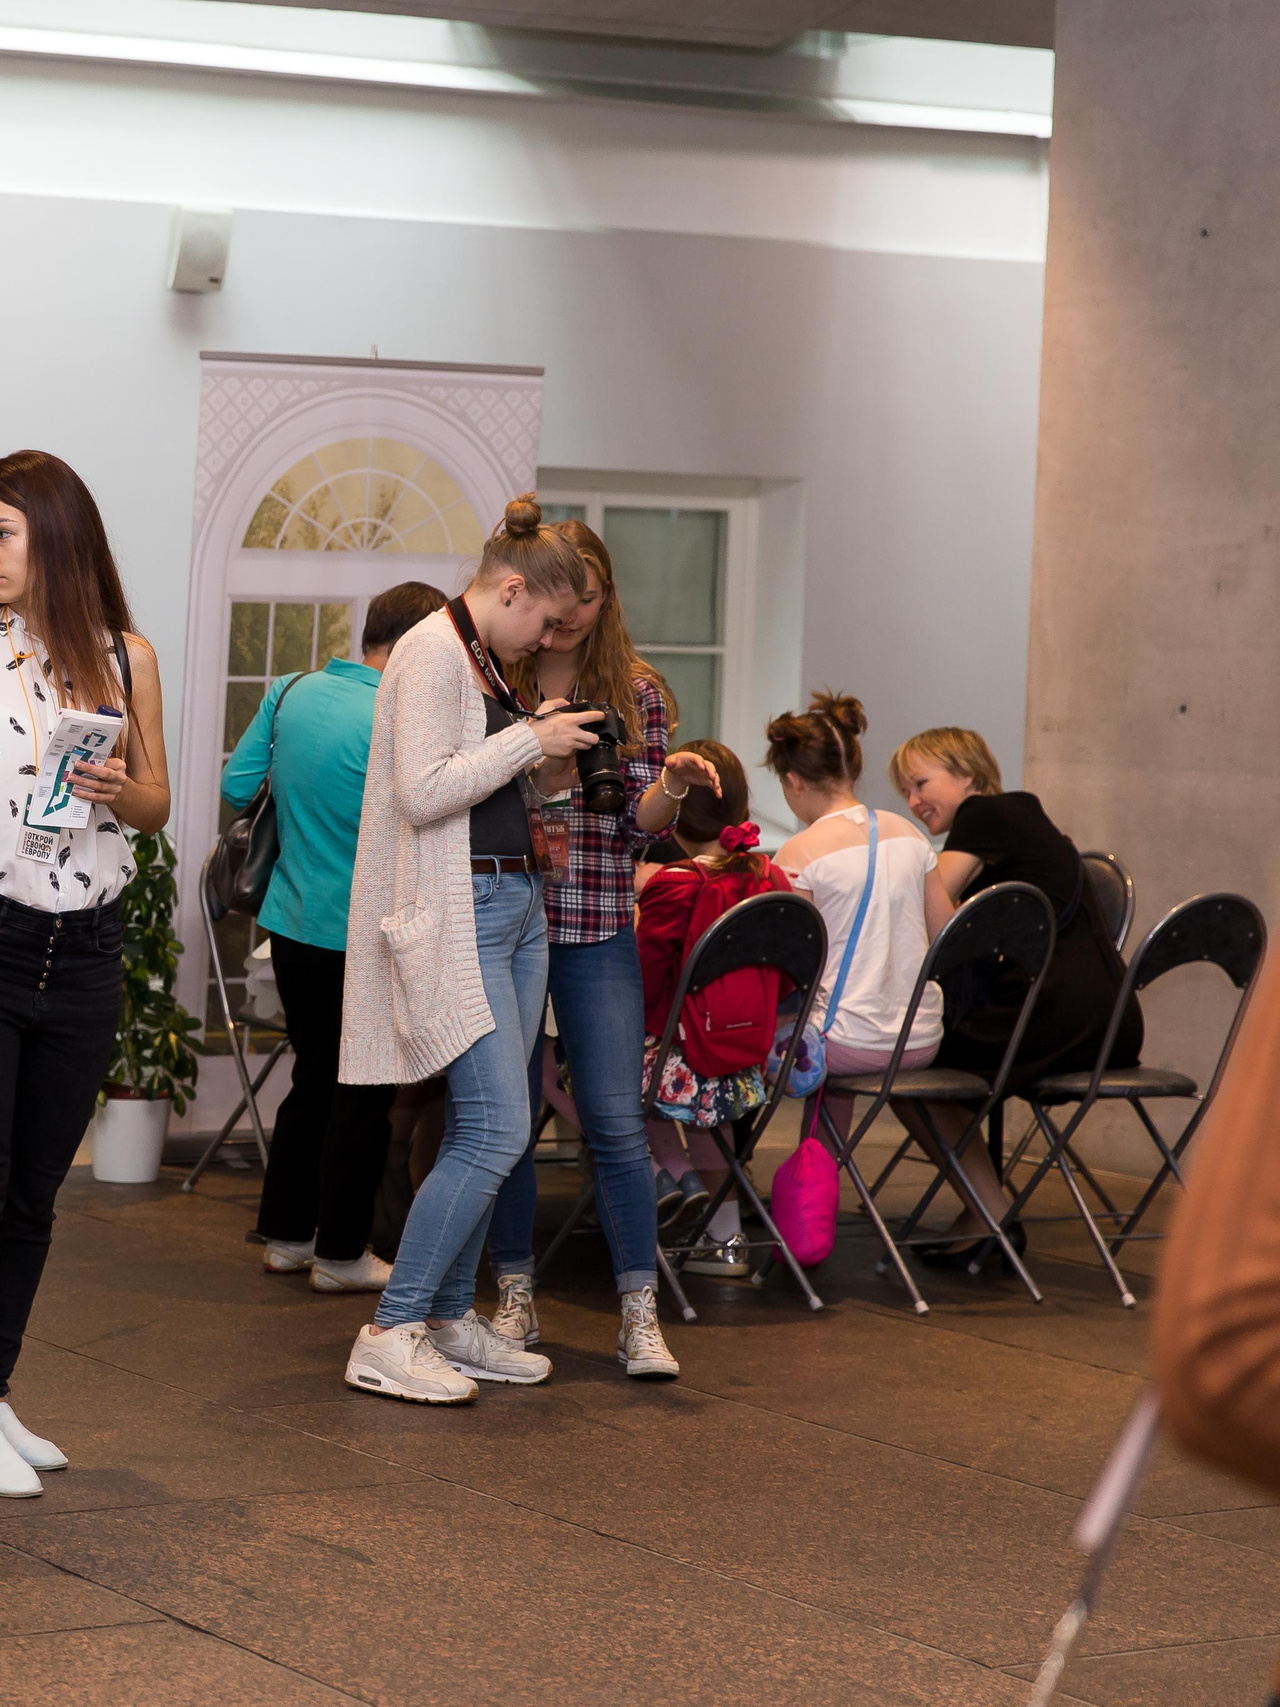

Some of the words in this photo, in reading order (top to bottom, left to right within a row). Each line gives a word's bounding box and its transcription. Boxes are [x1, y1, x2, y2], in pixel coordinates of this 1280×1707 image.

[470, 640, 486, 667] EOS
[28, 832, 54, 845] ОТКРОЙ
[26, 840, 45, 851] СВОЮ
[25, 847, 50, 859] ЕВРОПУ
